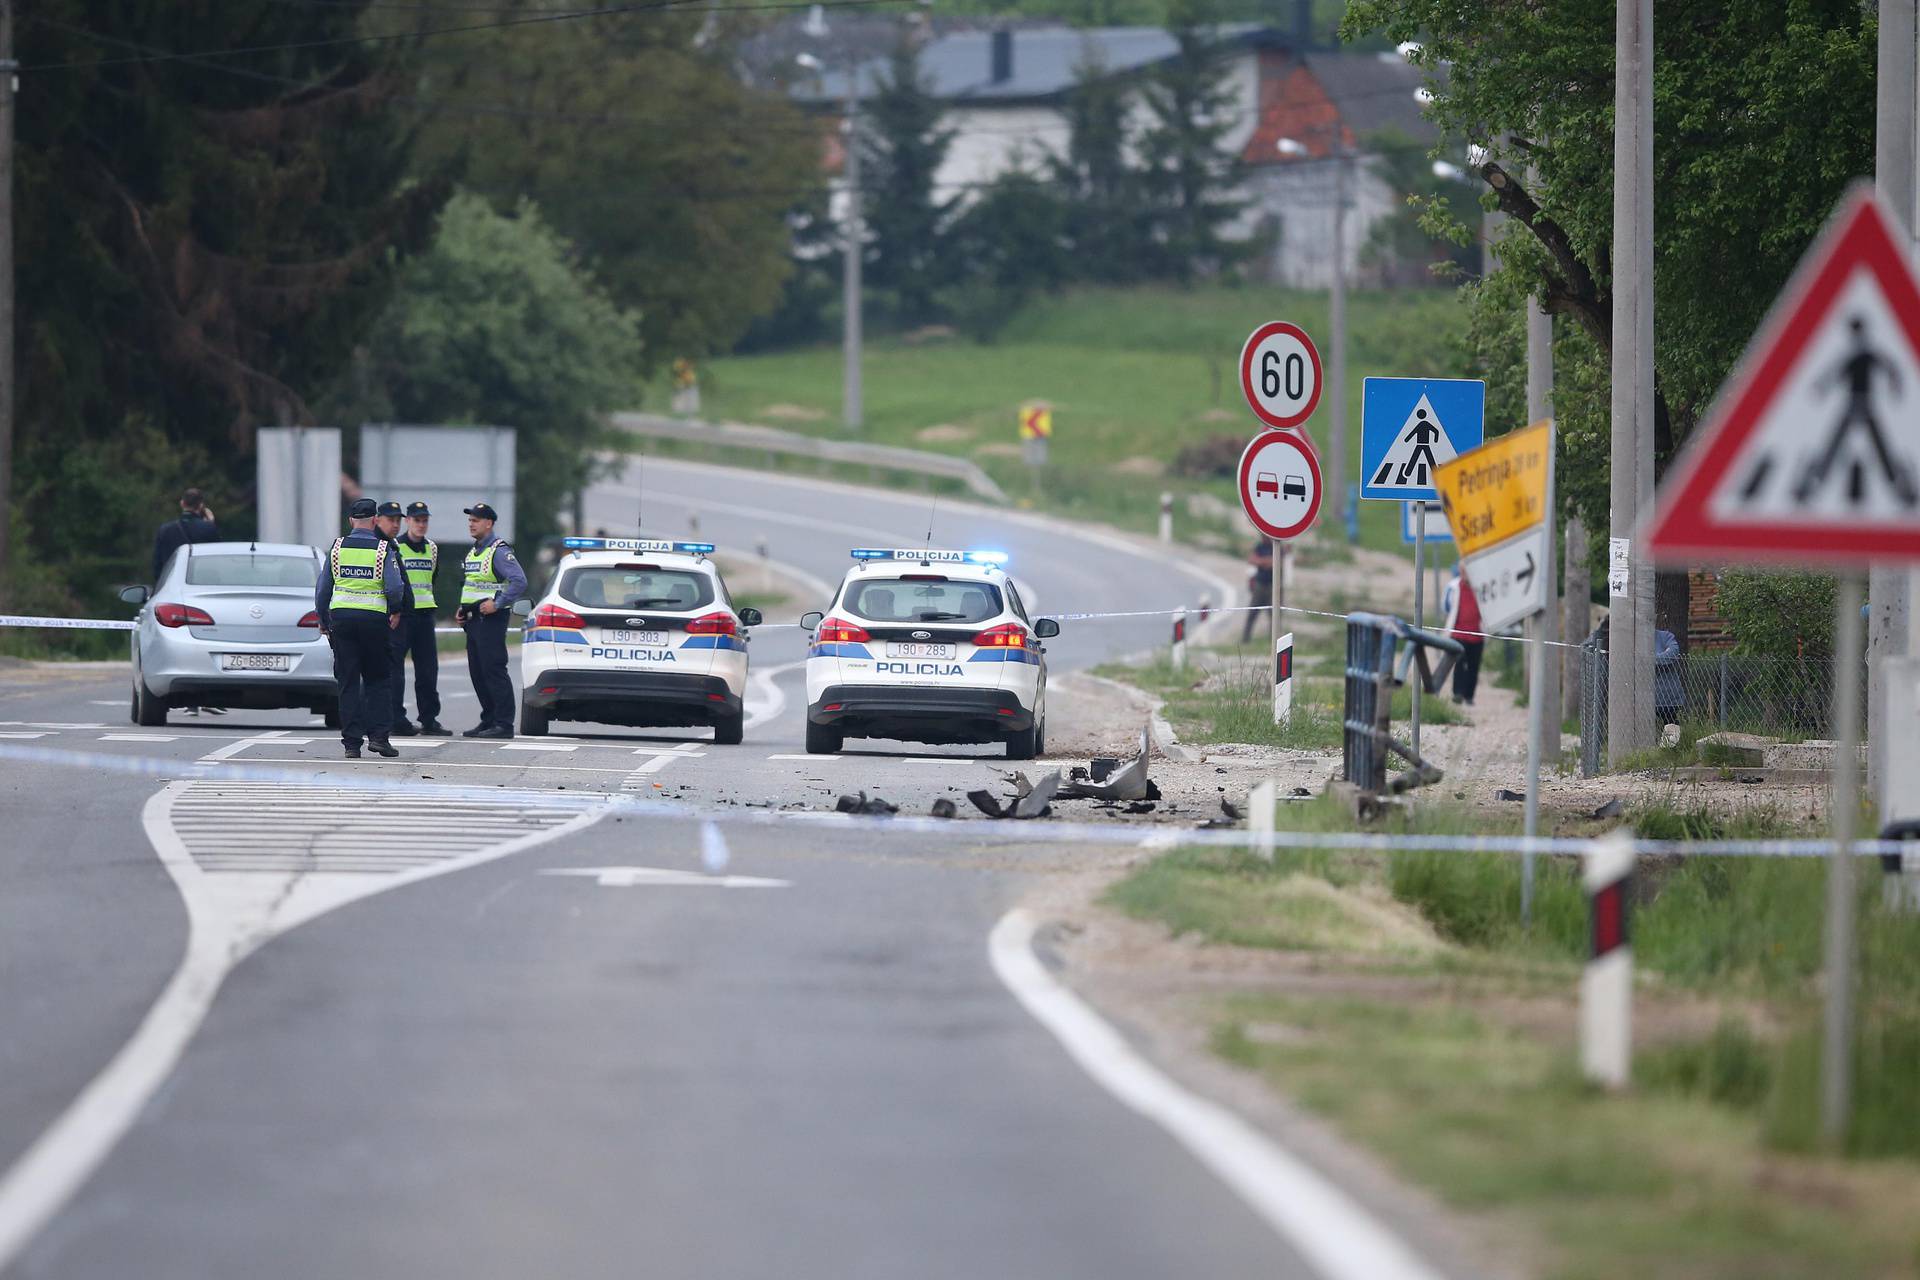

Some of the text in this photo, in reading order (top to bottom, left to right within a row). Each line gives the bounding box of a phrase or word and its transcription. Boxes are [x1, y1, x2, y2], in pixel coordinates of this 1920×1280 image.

[1262, 350, 1304, 400] 60
[1458, 457, 1511, 497] Petrinja
[1460, 502, 1495, 539] Sisak
[608, 540, 670, 551] POLICIJA
[897, 550, 960, 561] POLICIJA
[405, 561, 432, 569] POLICIJA
[341, 567, 373, 577] POLICIJA
[611, 630, 659, 643] 190 303
[591, 647, 677, 662] POLICIJA
[898, 643, 946, 656] 190 289
[230, 655, 243, 666] ZG
[876, 662, 964, 676] POLICIJA
